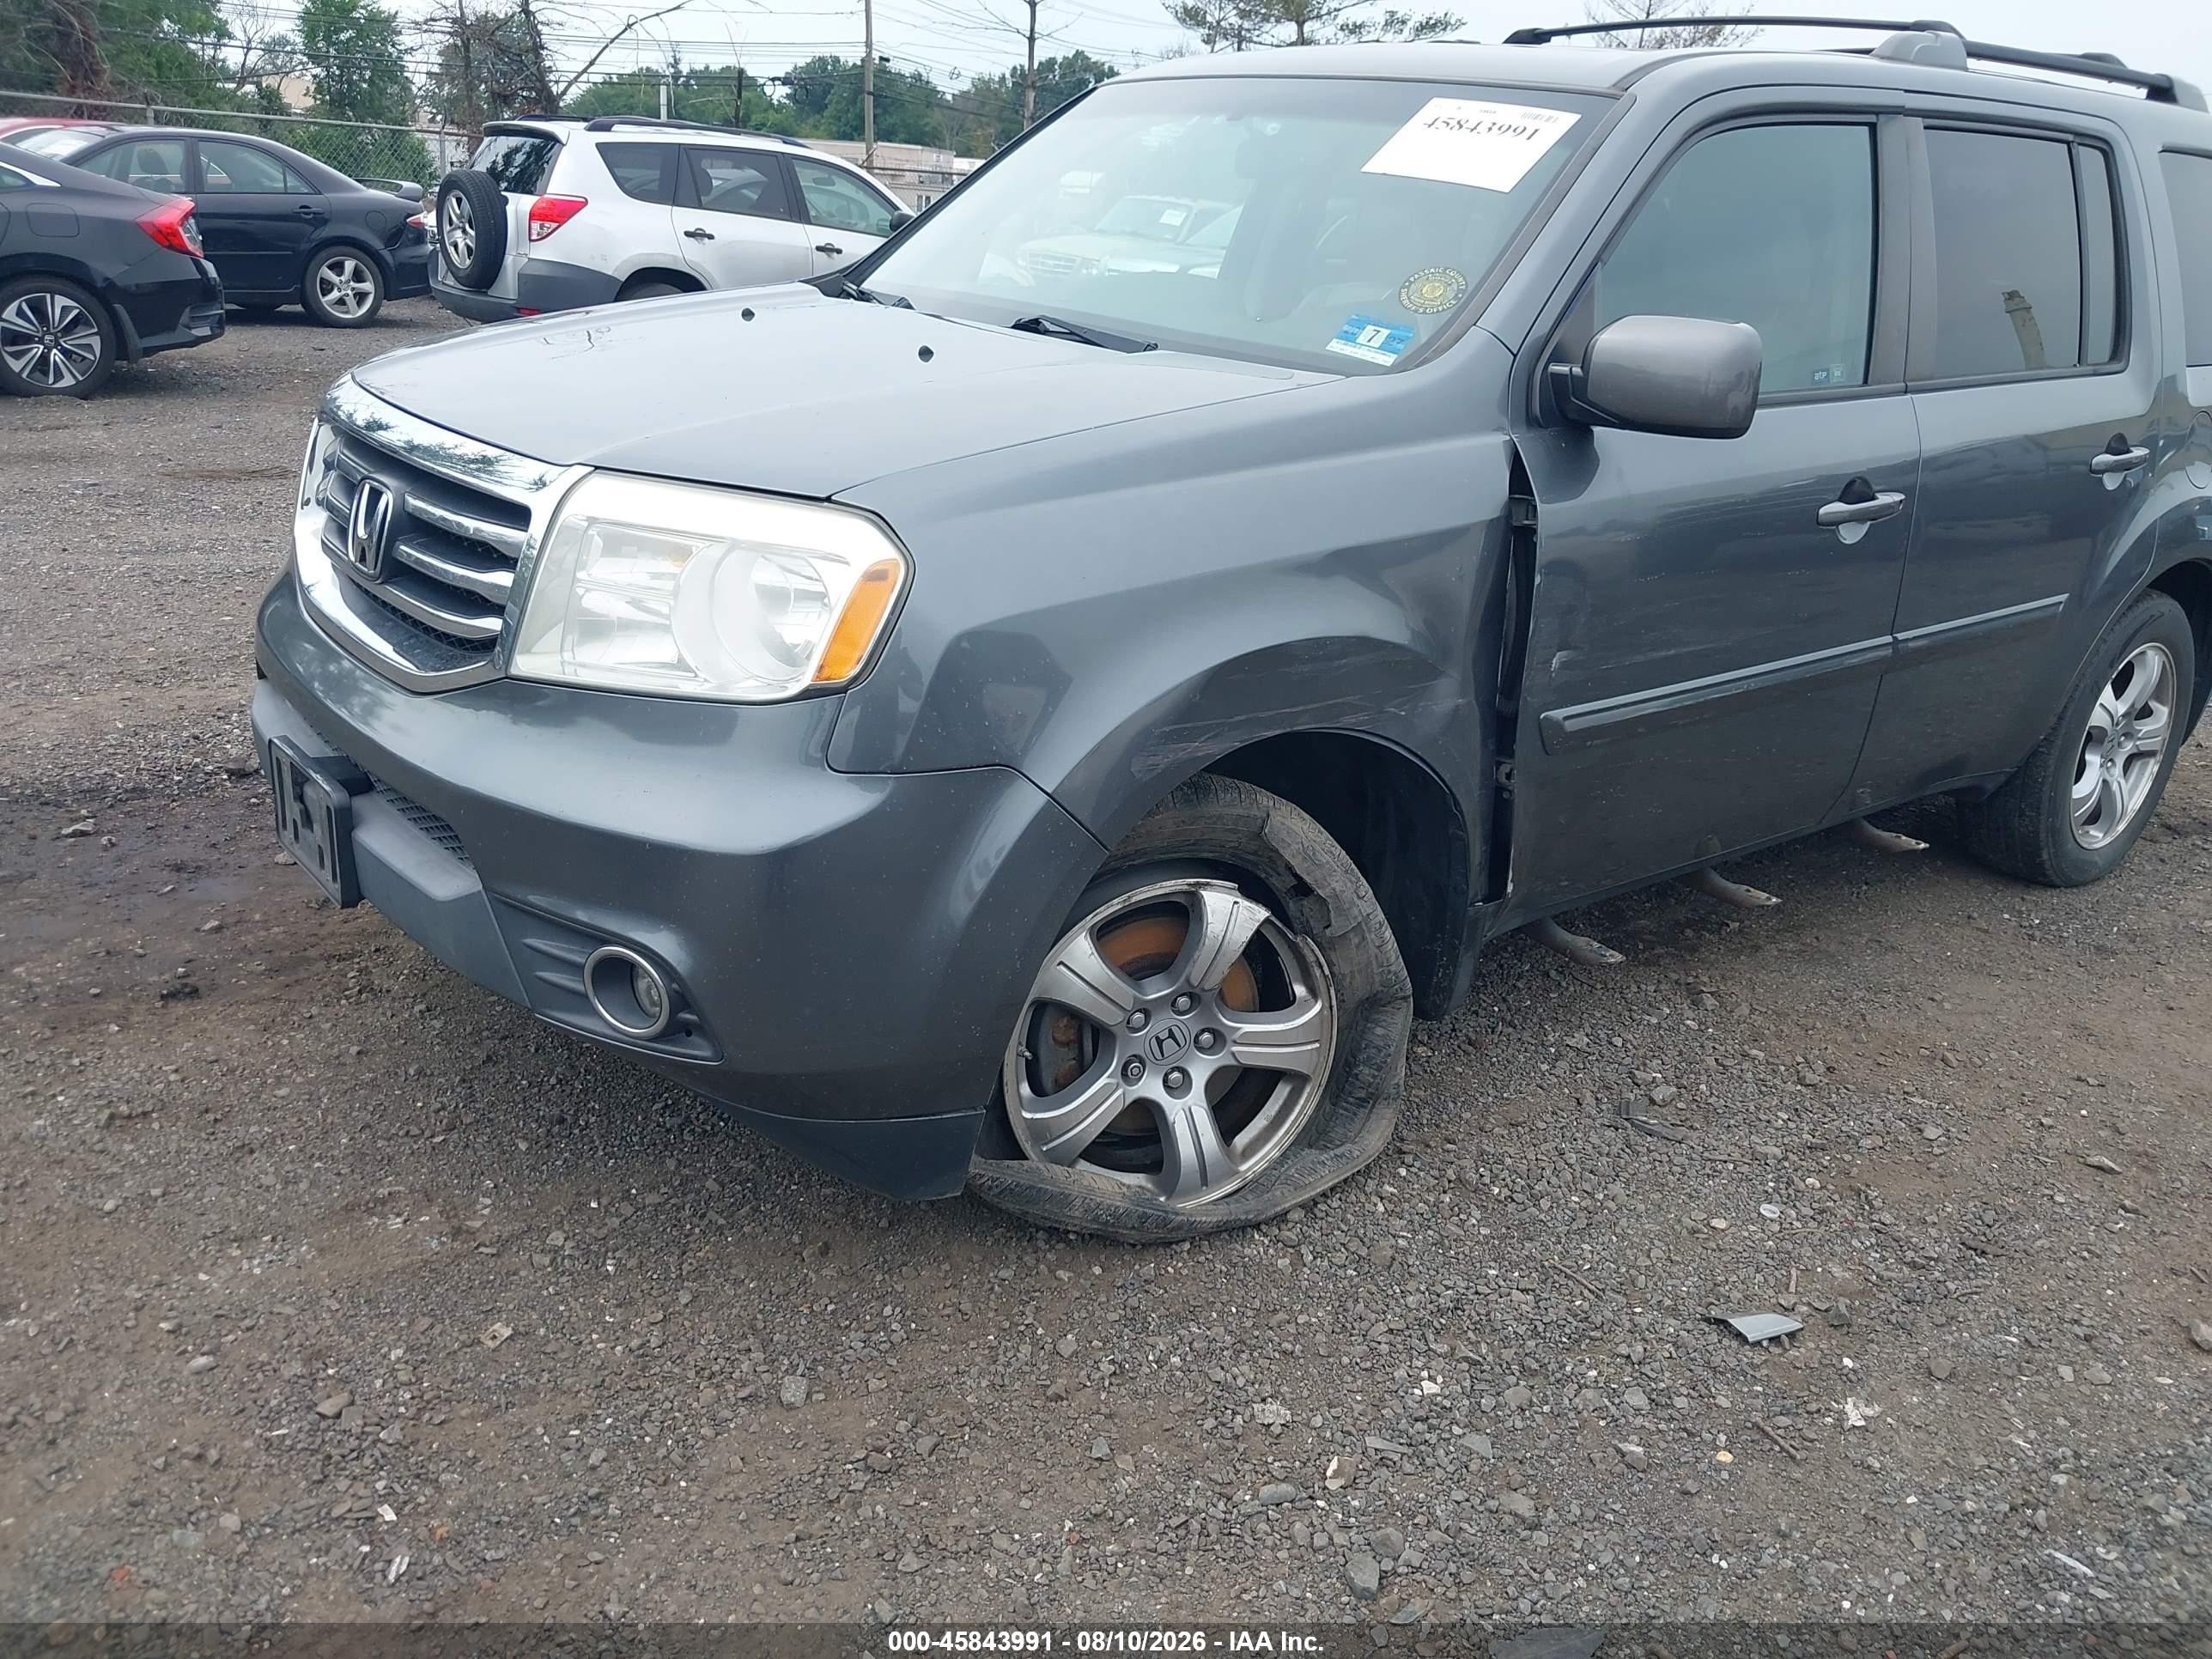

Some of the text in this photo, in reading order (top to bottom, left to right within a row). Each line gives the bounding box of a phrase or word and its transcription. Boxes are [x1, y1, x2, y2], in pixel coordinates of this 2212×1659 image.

[1423, 116, 1540, 141] 45843991
[1409, 267, 1444, 283] PASSAIC
[1445, 268, 1467, 289] COUNTY
[1425, 300, 1458, 313] OFFICE
[1366, 329, 1382, 343] 7
